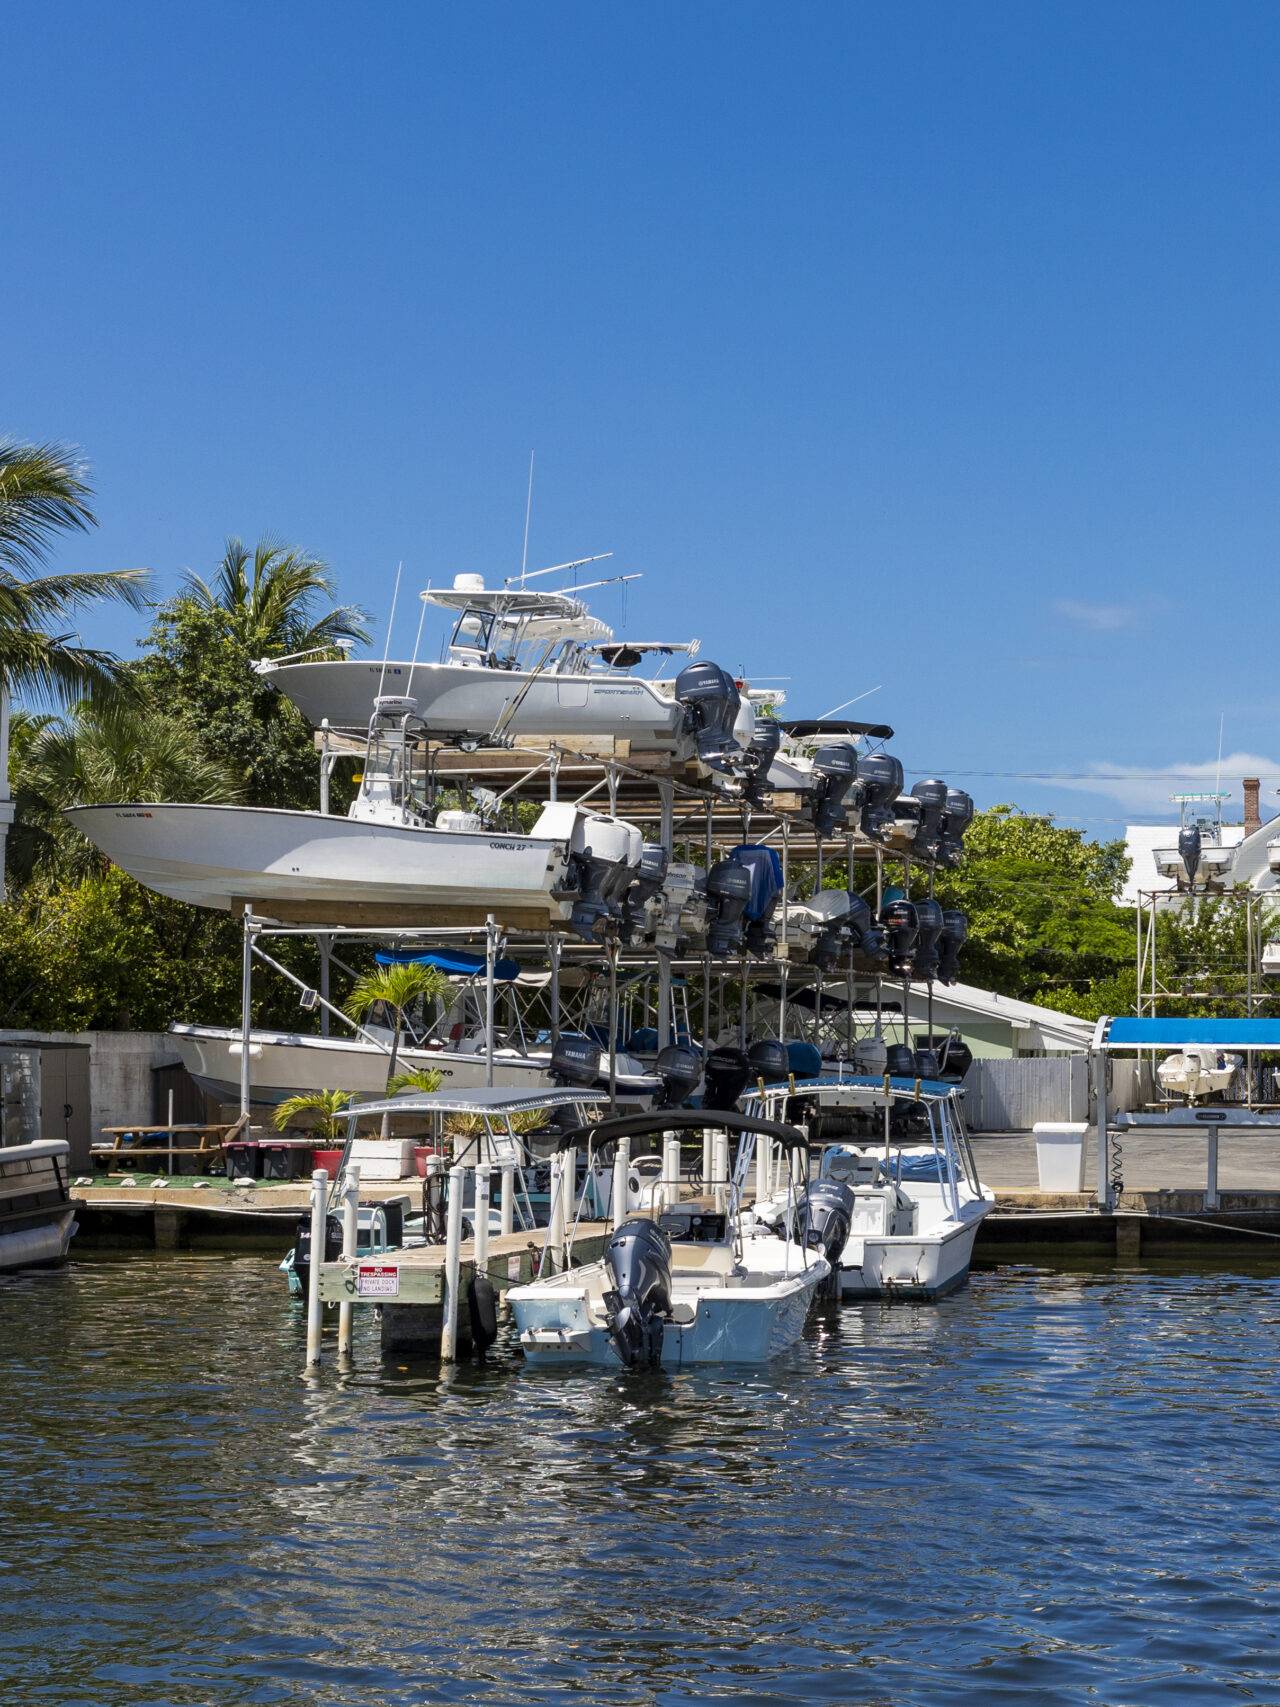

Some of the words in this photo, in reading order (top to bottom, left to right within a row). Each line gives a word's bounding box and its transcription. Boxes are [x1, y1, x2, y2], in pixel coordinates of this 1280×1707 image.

[490, 842, 515, 850] CONCH
[667, 871, 687, 879] ohnson
[565, 1050, 586, 1060] YAMAHA
